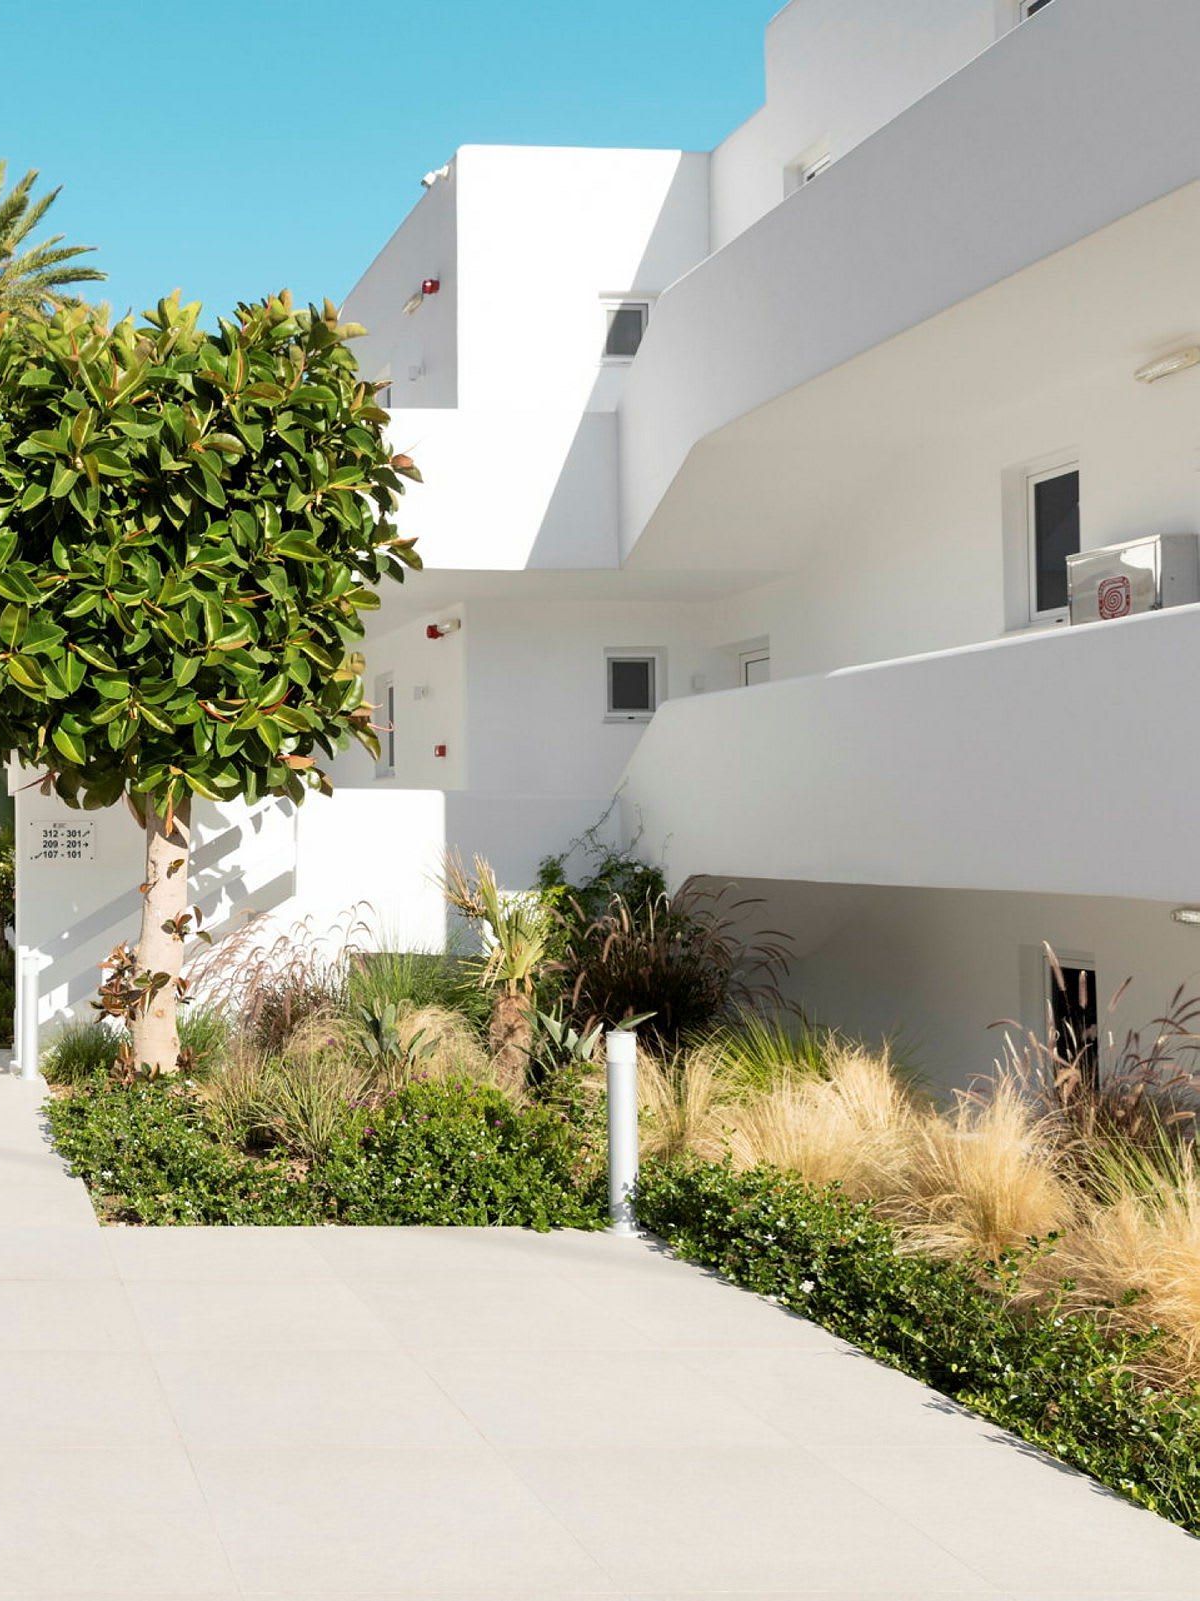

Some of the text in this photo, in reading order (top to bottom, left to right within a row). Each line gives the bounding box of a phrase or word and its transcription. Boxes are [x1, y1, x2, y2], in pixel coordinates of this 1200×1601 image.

[42, 829, 59, 838] 312
[66, 829, 82, 838] 301
[42, 839, 59, 849] 209
[66, 839, 82, 849] 201
[42, 849, 59, 859] 107
[67, 849, 82, 859] 101
